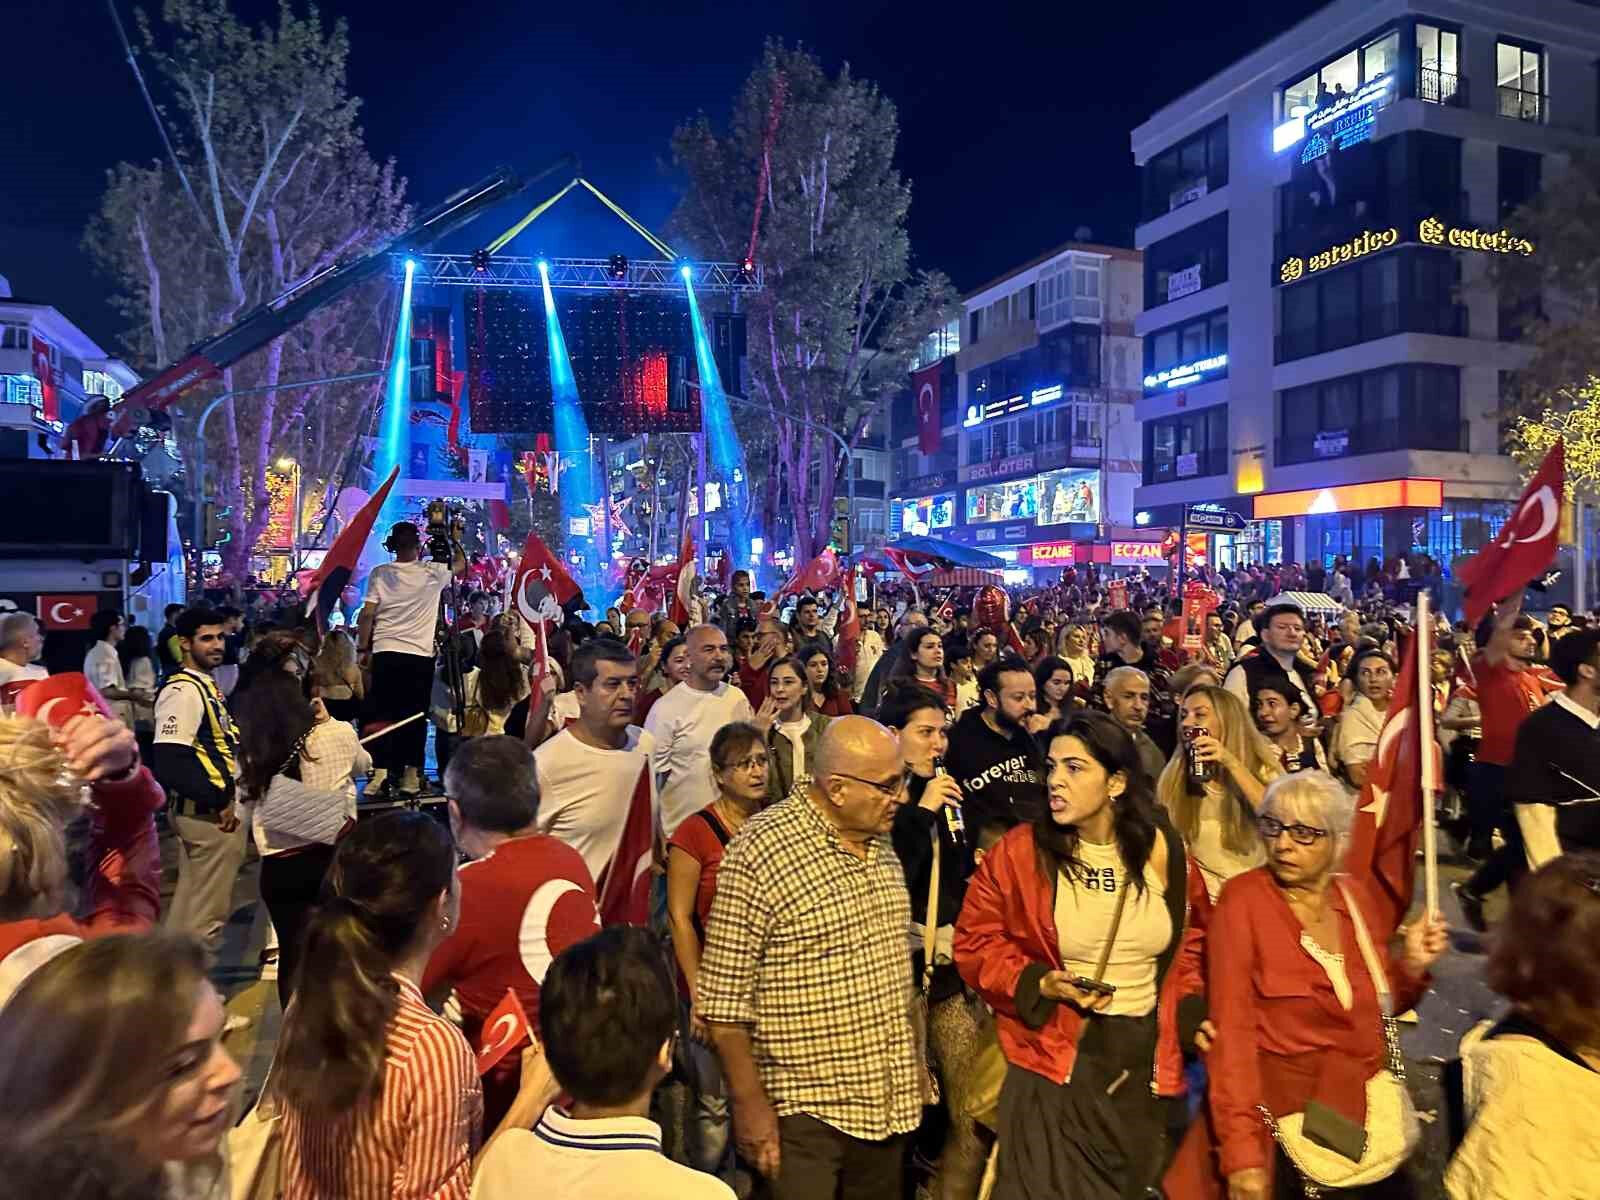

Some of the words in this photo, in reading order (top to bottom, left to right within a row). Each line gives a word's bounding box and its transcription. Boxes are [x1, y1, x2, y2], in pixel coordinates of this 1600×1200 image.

[1309, 227, 1398, 271] estetico
[1032, 545, 1073, 559] ECZANE
[1114, 543, 1162, 558] ECZAN
[962, 754, 1027, 792] forever
